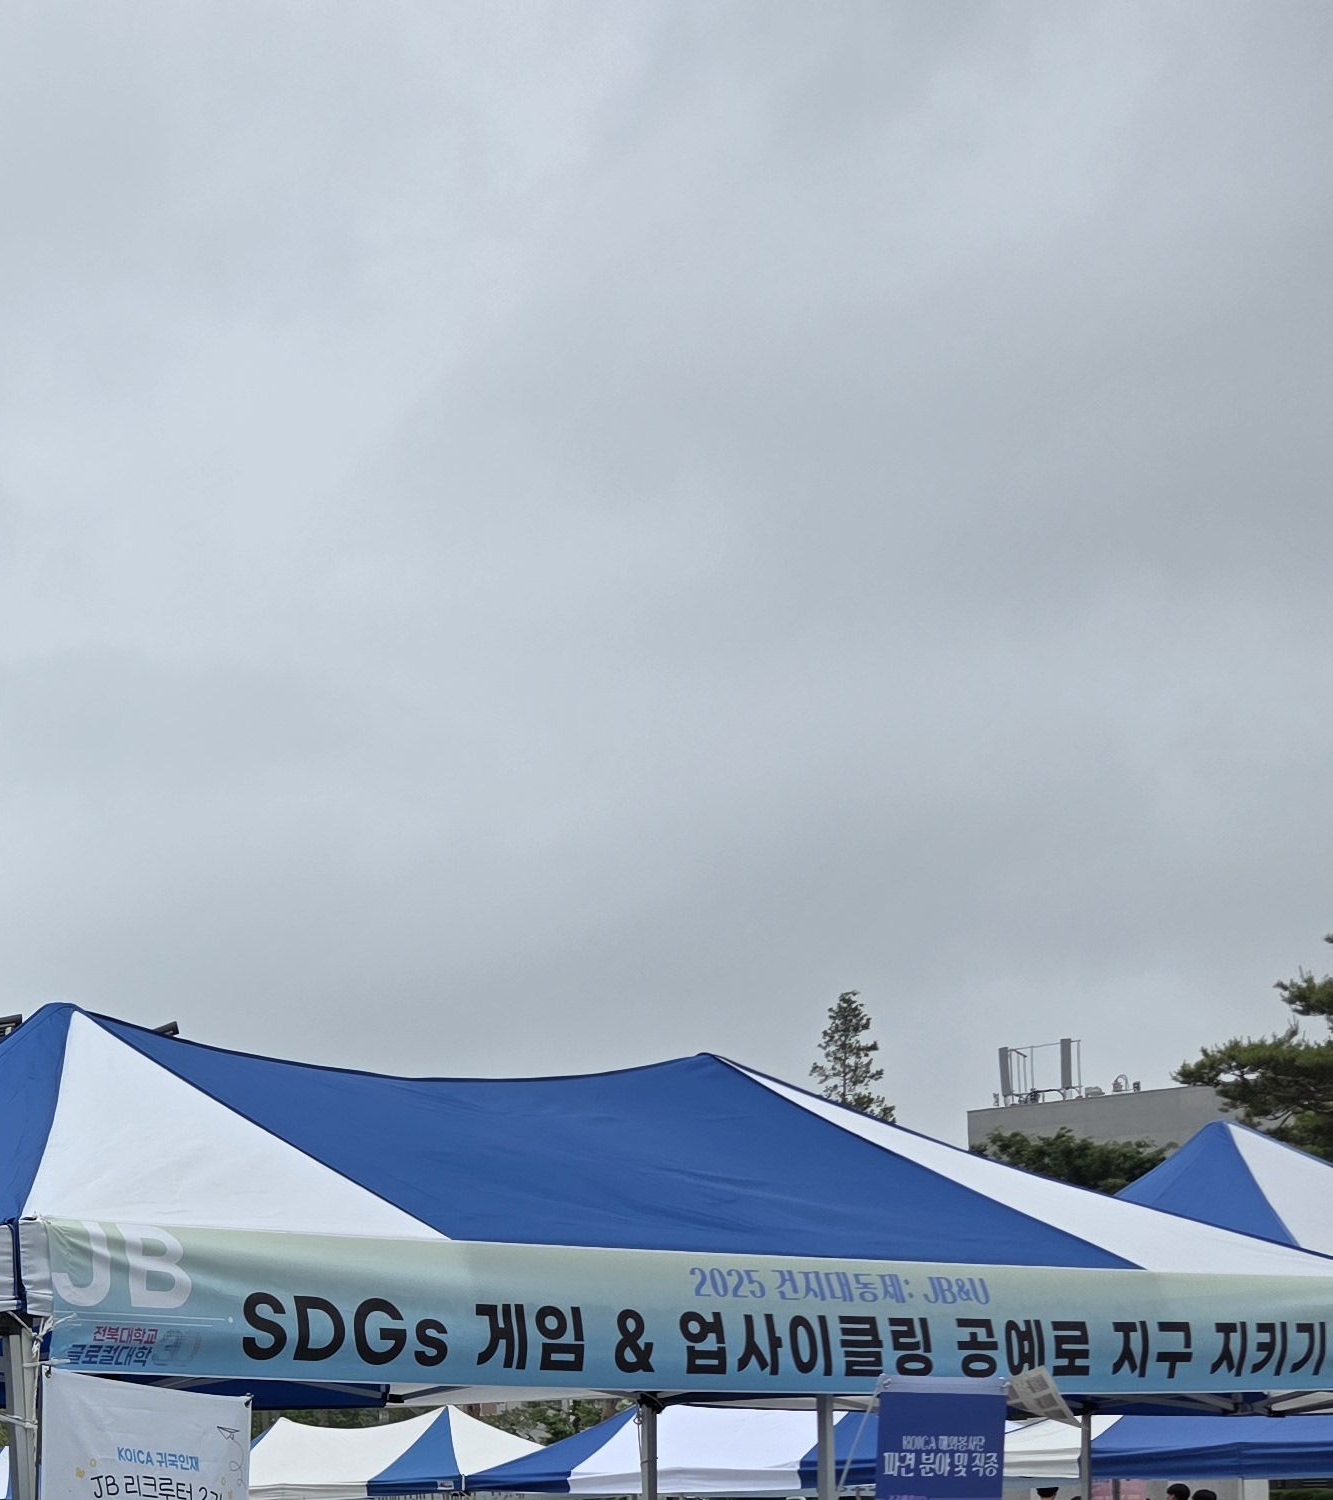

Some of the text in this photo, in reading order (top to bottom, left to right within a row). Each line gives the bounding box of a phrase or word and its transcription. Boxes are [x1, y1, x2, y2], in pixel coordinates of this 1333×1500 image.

[53, 1220, 193, 1308] JB
[689, 1266, 991, 1305] 2025 건지대동제: JB&U
[93, 1325, 159, 1345] 전북대학교
[241, 1291, 1326, 1379] SDGs 게임 & 업사이클링 공예로 지구 지키기
[67, 1343, 154, 1367] 글로컬대학
[117, 1446, 200, 1473] KOICA 귀국인재
[883, 1452, 999, 1477] 파견 분야 및 직종
[90, 1474, 120, 1499] JB
